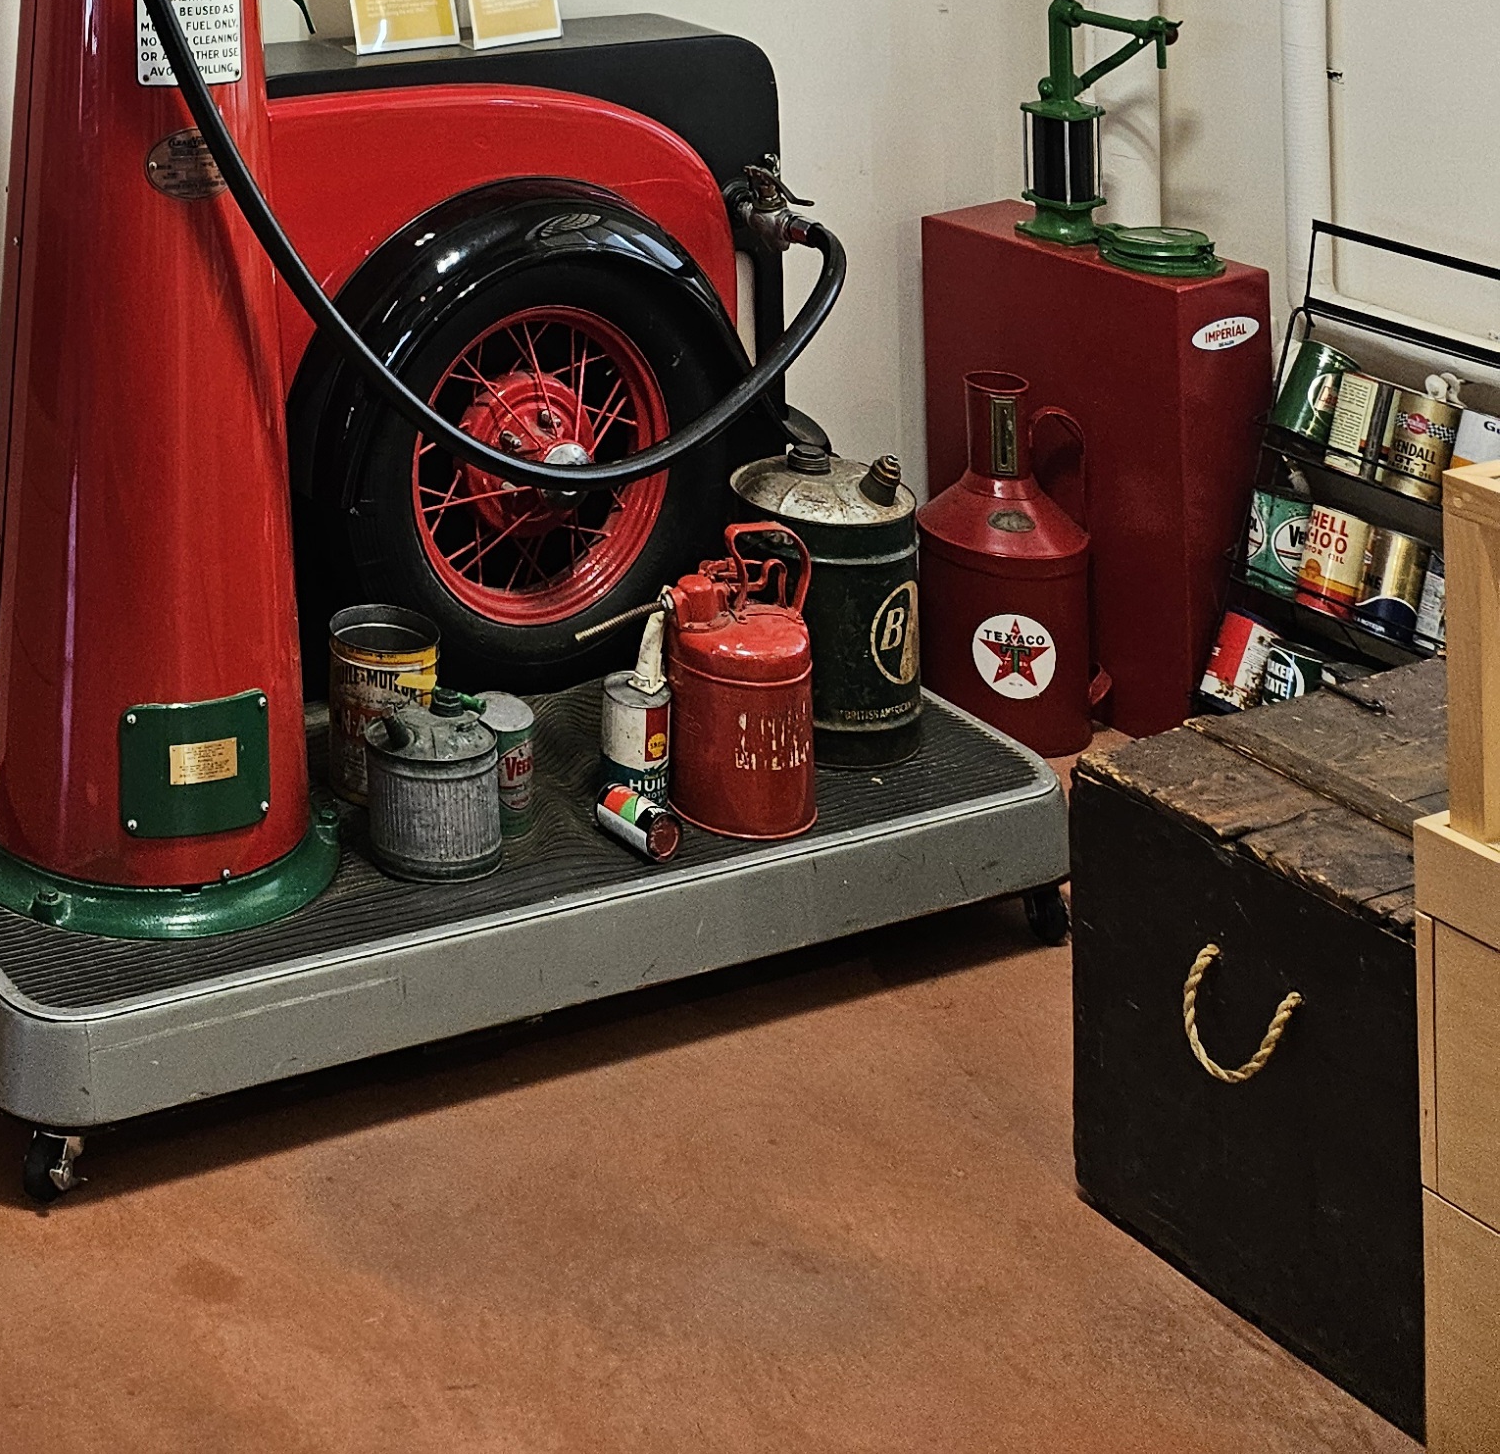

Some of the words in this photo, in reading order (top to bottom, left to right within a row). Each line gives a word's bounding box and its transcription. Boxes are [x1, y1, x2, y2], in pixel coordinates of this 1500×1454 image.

[180, 6, 193, 17] BE
[196, 5, 221, 16] USED
[222, 3, 234, 14] AS
[186, 20, 211, 31] FUEL
[192, 33, 238, 46] CLEANING
[141, 51, 158, 62] OR
[194, 48, 219, 61] THER
[150, 66, 173, 77] AVO
[1205, 323, 1247, 343] IMPERIAL
[1311, 509, 1349, 538] HELL
[984, 629, 1046, 646] TEXACO
[1002, 645, 1030, 673] T
